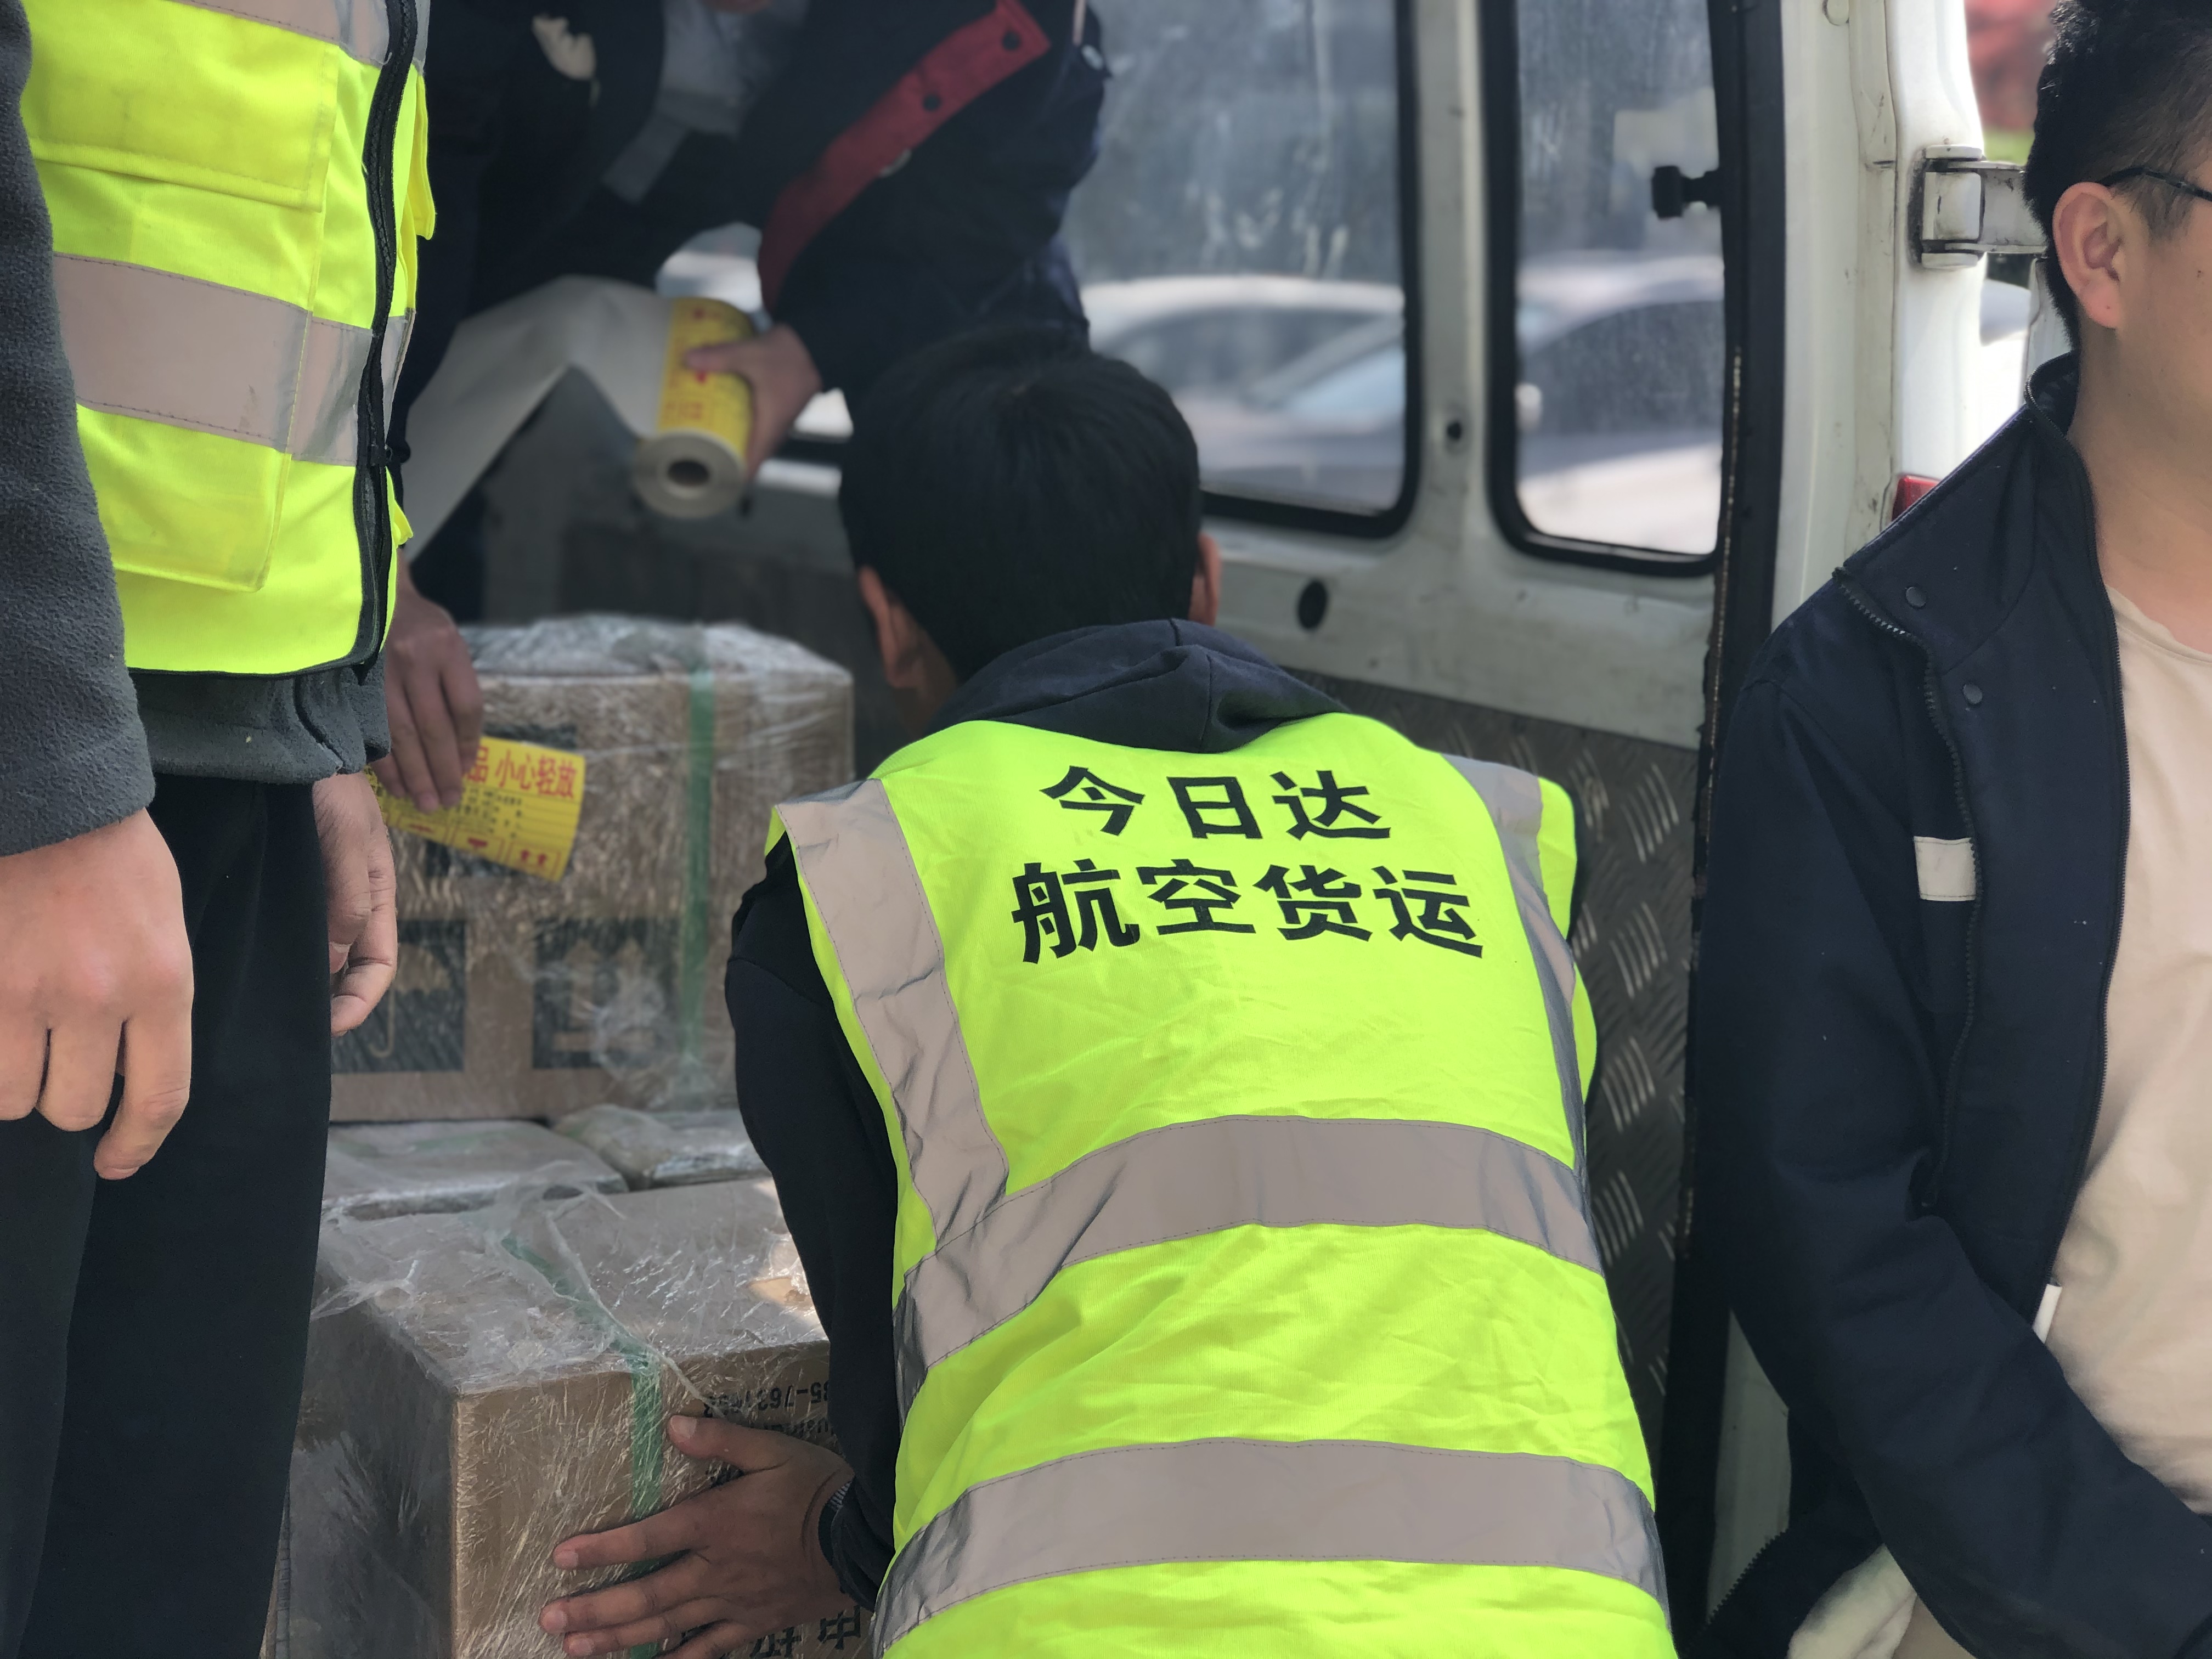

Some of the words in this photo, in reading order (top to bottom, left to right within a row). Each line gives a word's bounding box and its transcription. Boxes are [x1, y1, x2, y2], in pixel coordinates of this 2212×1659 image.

[1039, 765, 1392, 840] 今日达
[1010, 858, 1483, 964] 航空货运
